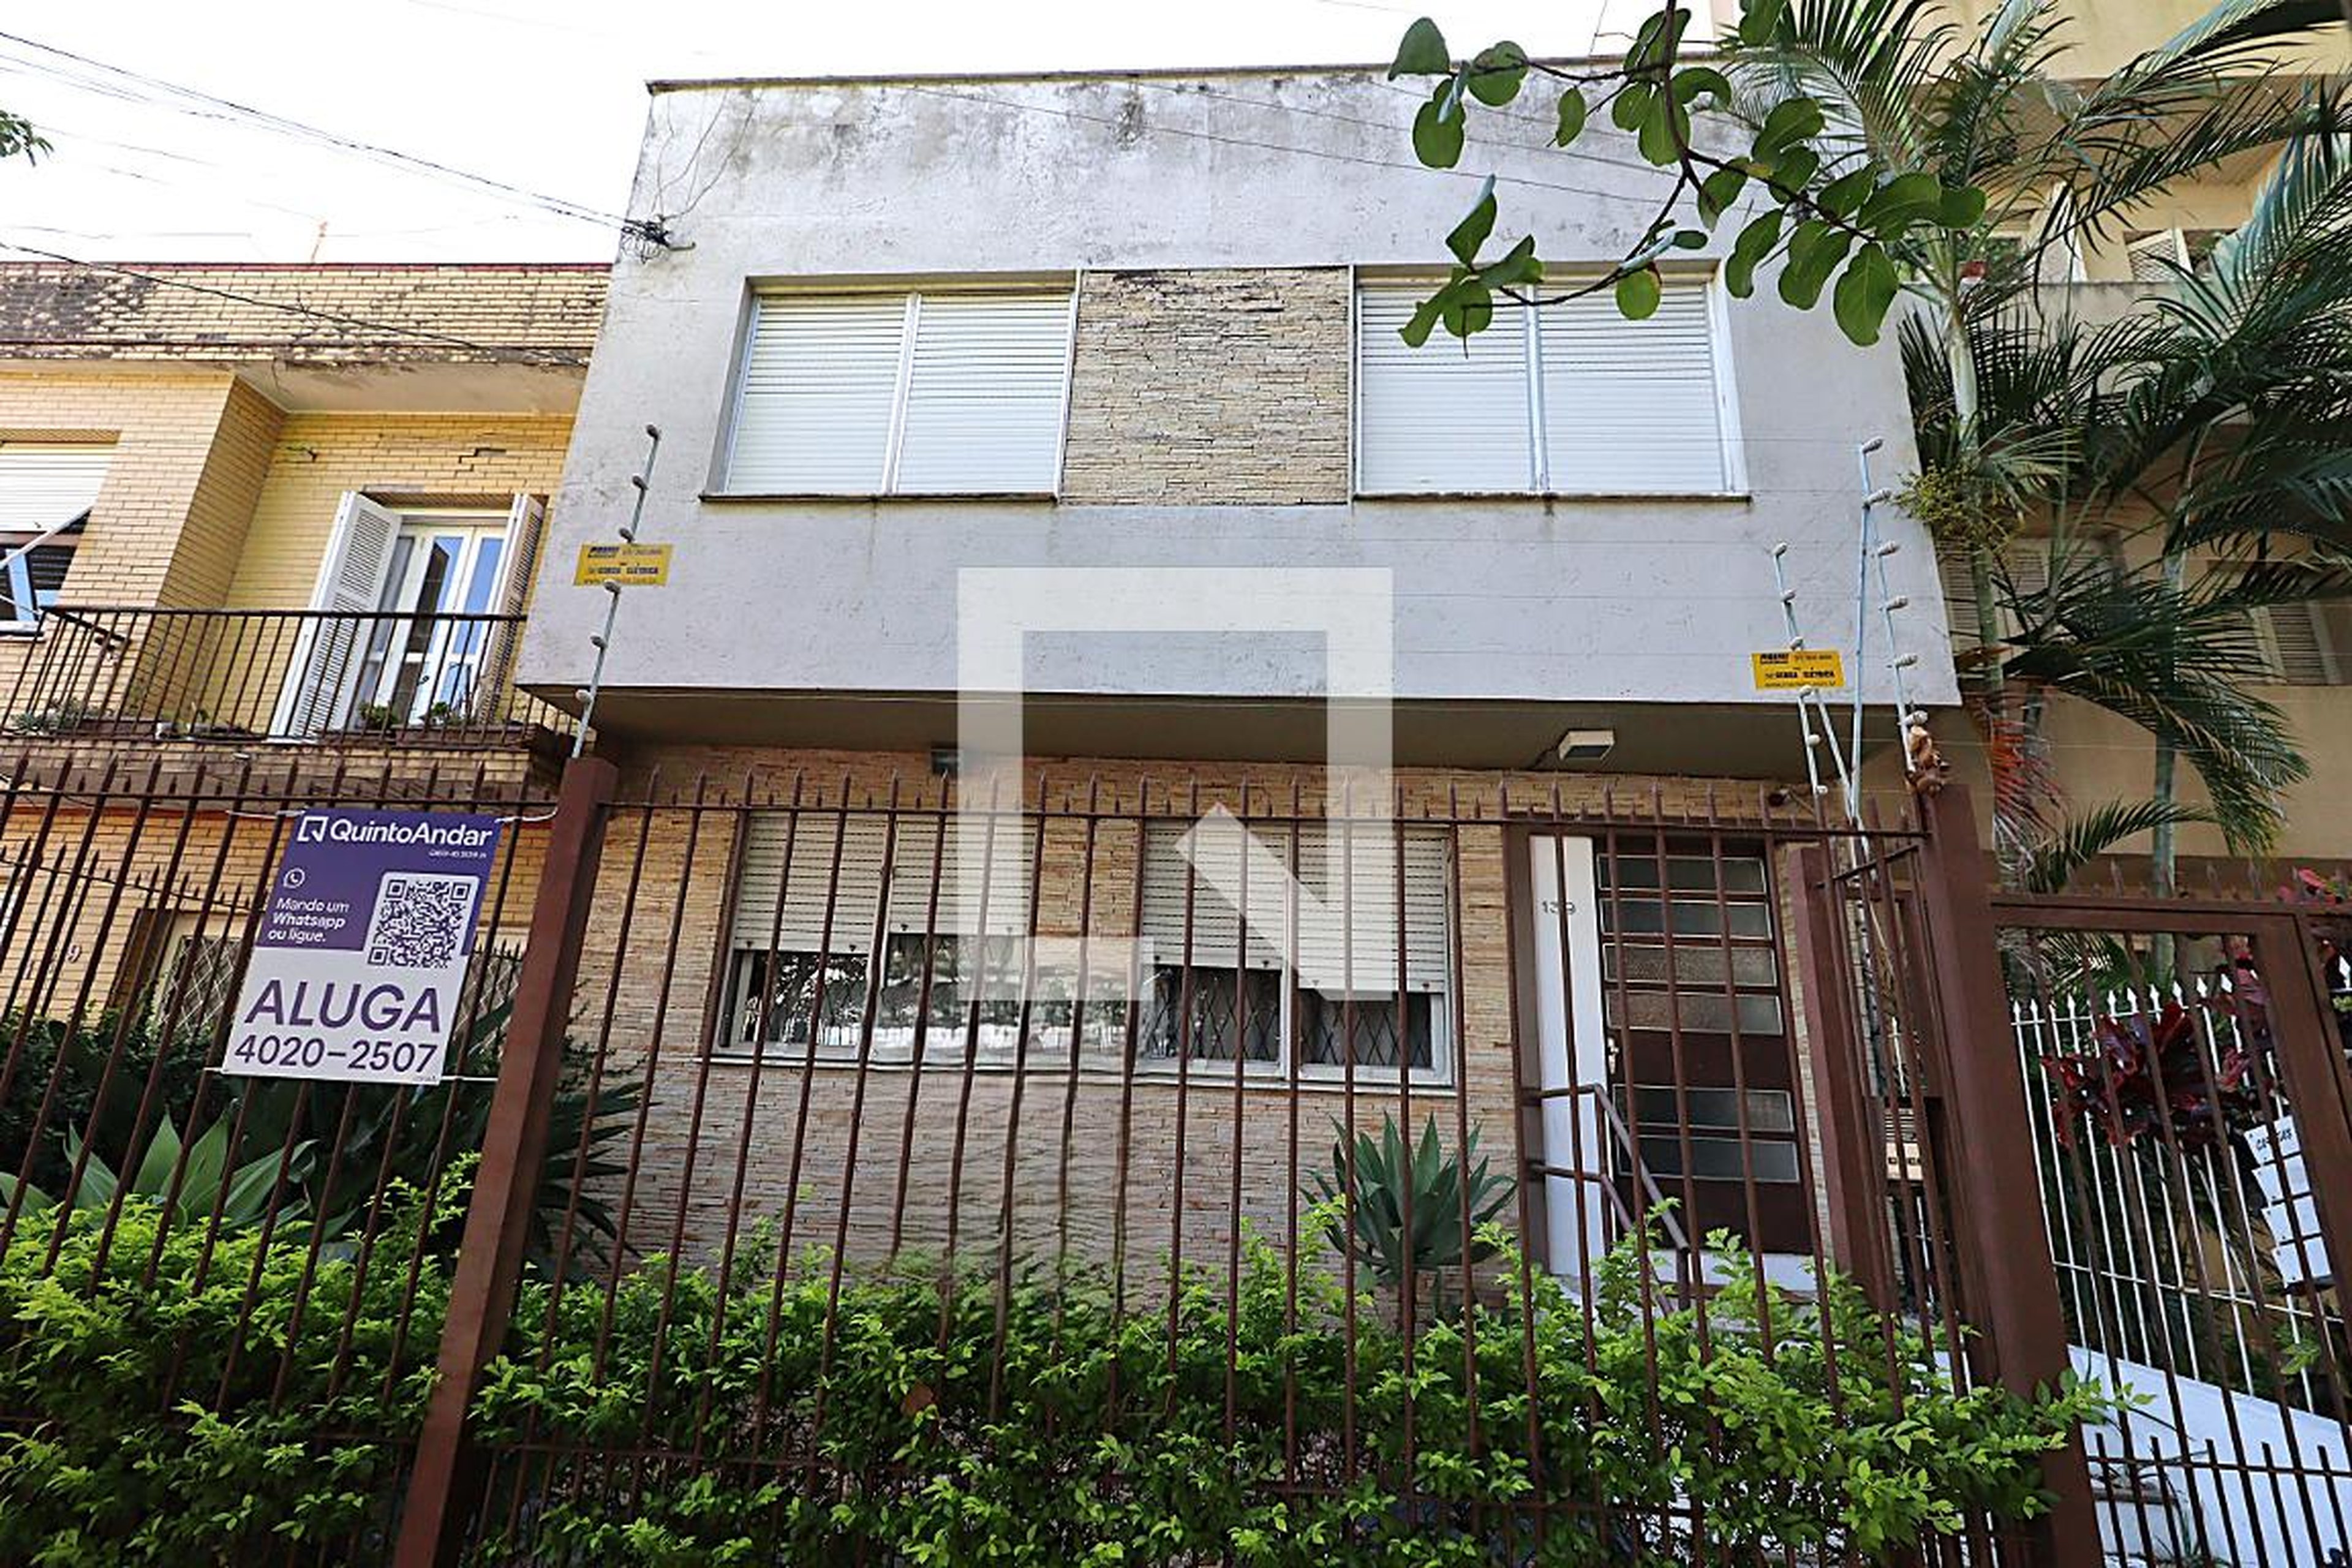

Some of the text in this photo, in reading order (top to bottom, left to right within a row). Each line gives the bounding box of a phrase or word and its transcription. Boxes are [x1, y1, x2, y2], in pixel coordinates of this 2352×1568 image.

[330, 818, 492, 846] QuintoAndar
[326, 902, 350, 913] um
[273, 911, 346, 930] Whatsapp
[268, 926, 326, 944] ou ligue.
[244, 979, 441, 1033] ALUGA
[234, 1035, 439, 1074] 4020-2507
